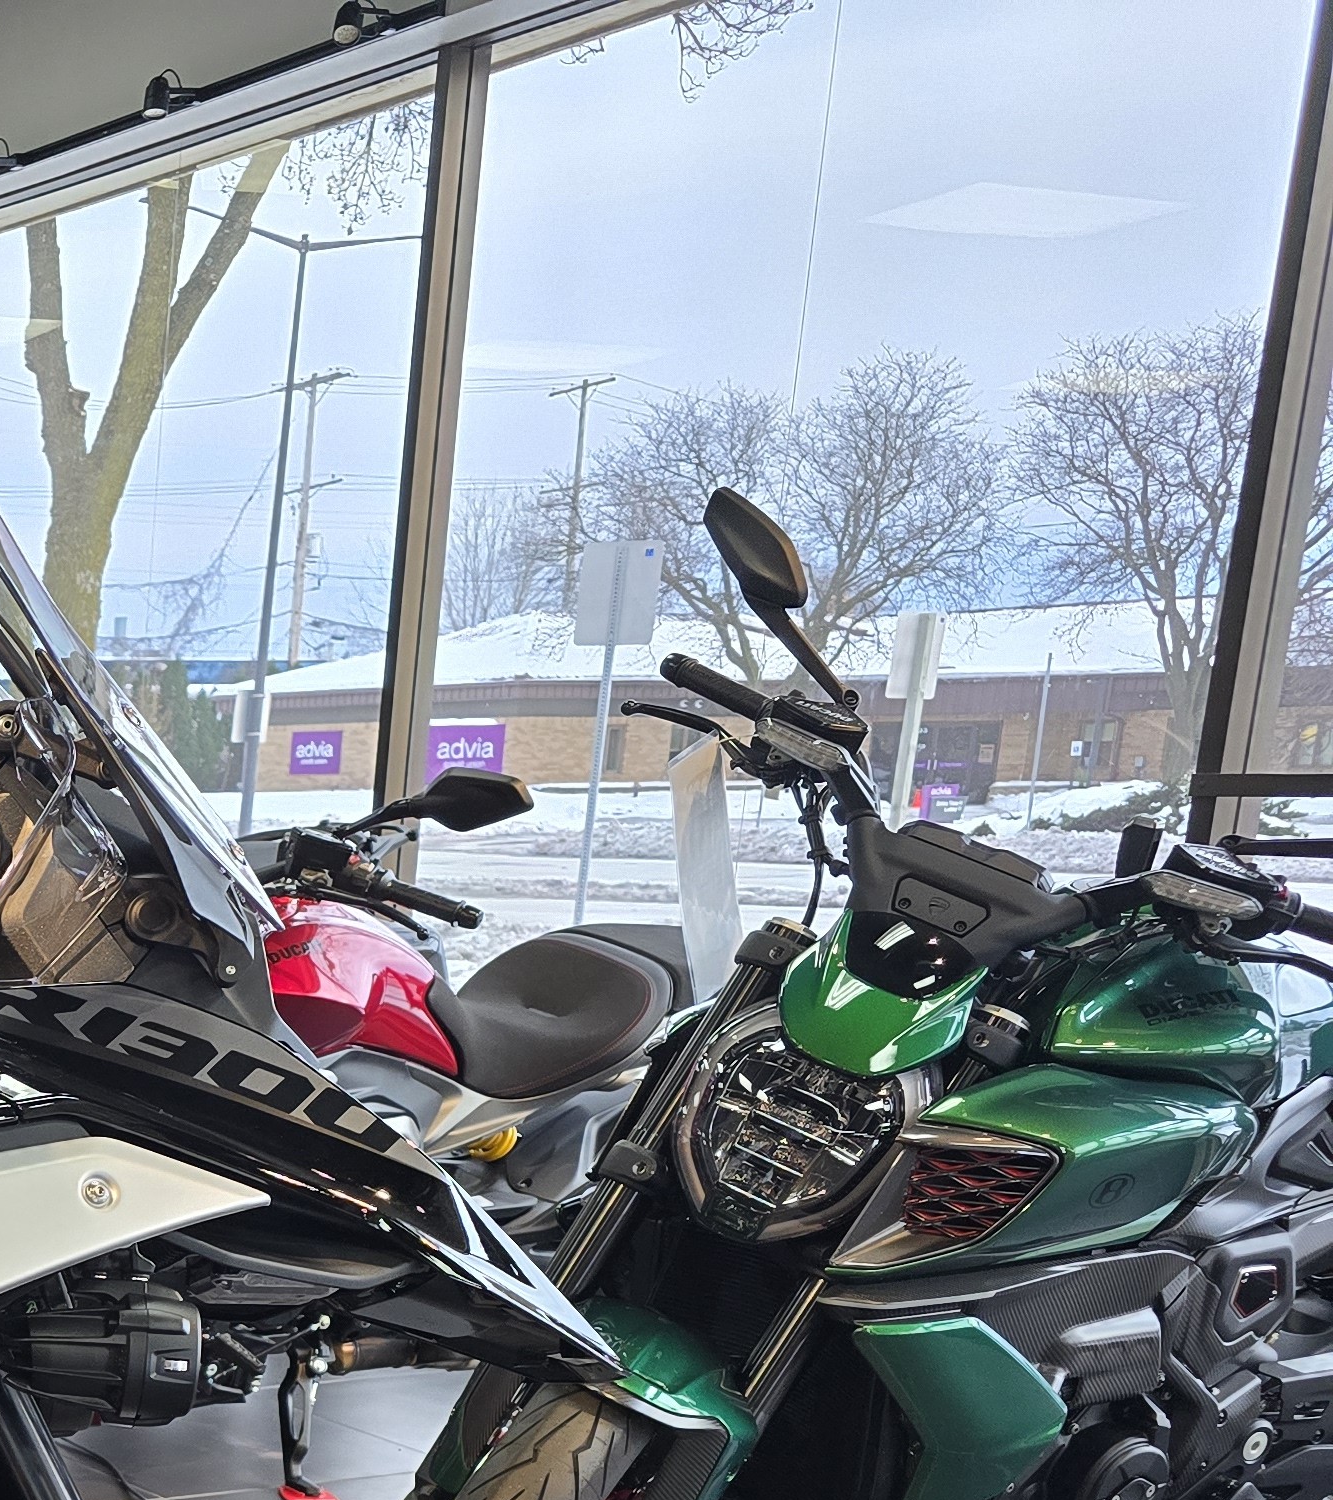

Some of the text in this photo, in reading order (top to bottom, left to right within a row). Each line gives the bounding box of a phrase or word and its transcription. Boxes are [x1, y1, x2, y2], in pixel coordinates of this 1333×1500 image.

[295, 740, 334, 758] advia
[436, 737, 494, 759] advia
[267, 940, 312, 965] DUCA
